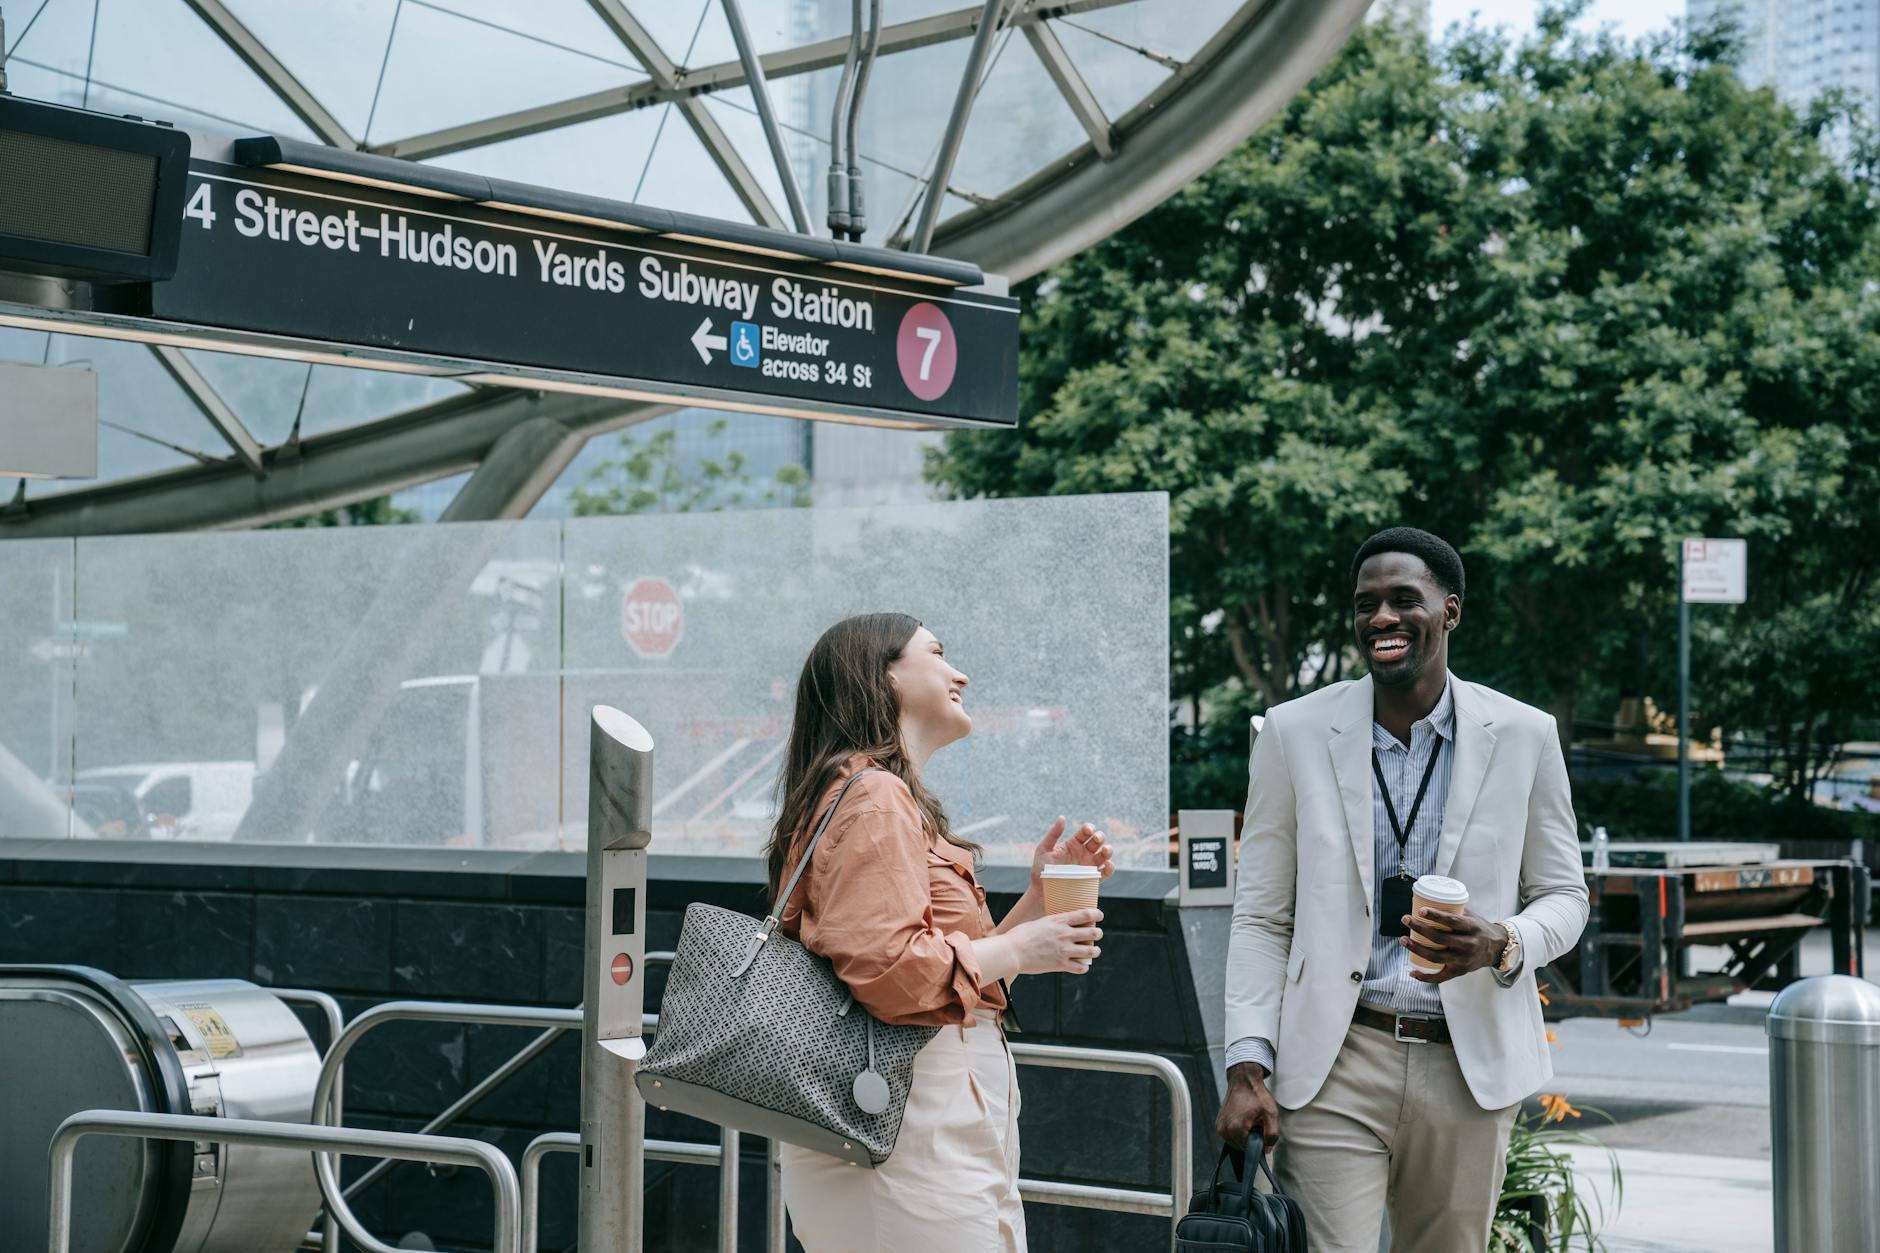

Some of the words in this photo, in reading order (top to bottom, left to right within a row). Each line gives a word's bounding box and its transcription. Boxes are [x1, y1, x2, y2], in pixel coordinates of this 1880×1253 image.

[183, 182, 217, 230] 4
[234, 189, 517, 277] Street-Hudson
[532, 239, 626, 294] Yards
[638, 256, 760, 321] Subway
[770, 277, 873, 331] Station
[761, 325, 830, 357] Elevator
[915, 326, 942, 382] 7
[761, 358, 820, 383] across
[824, 360, 848, 386] 34
[852, 363, 872, 389] St
[627, 601, 678, 633] STOP
